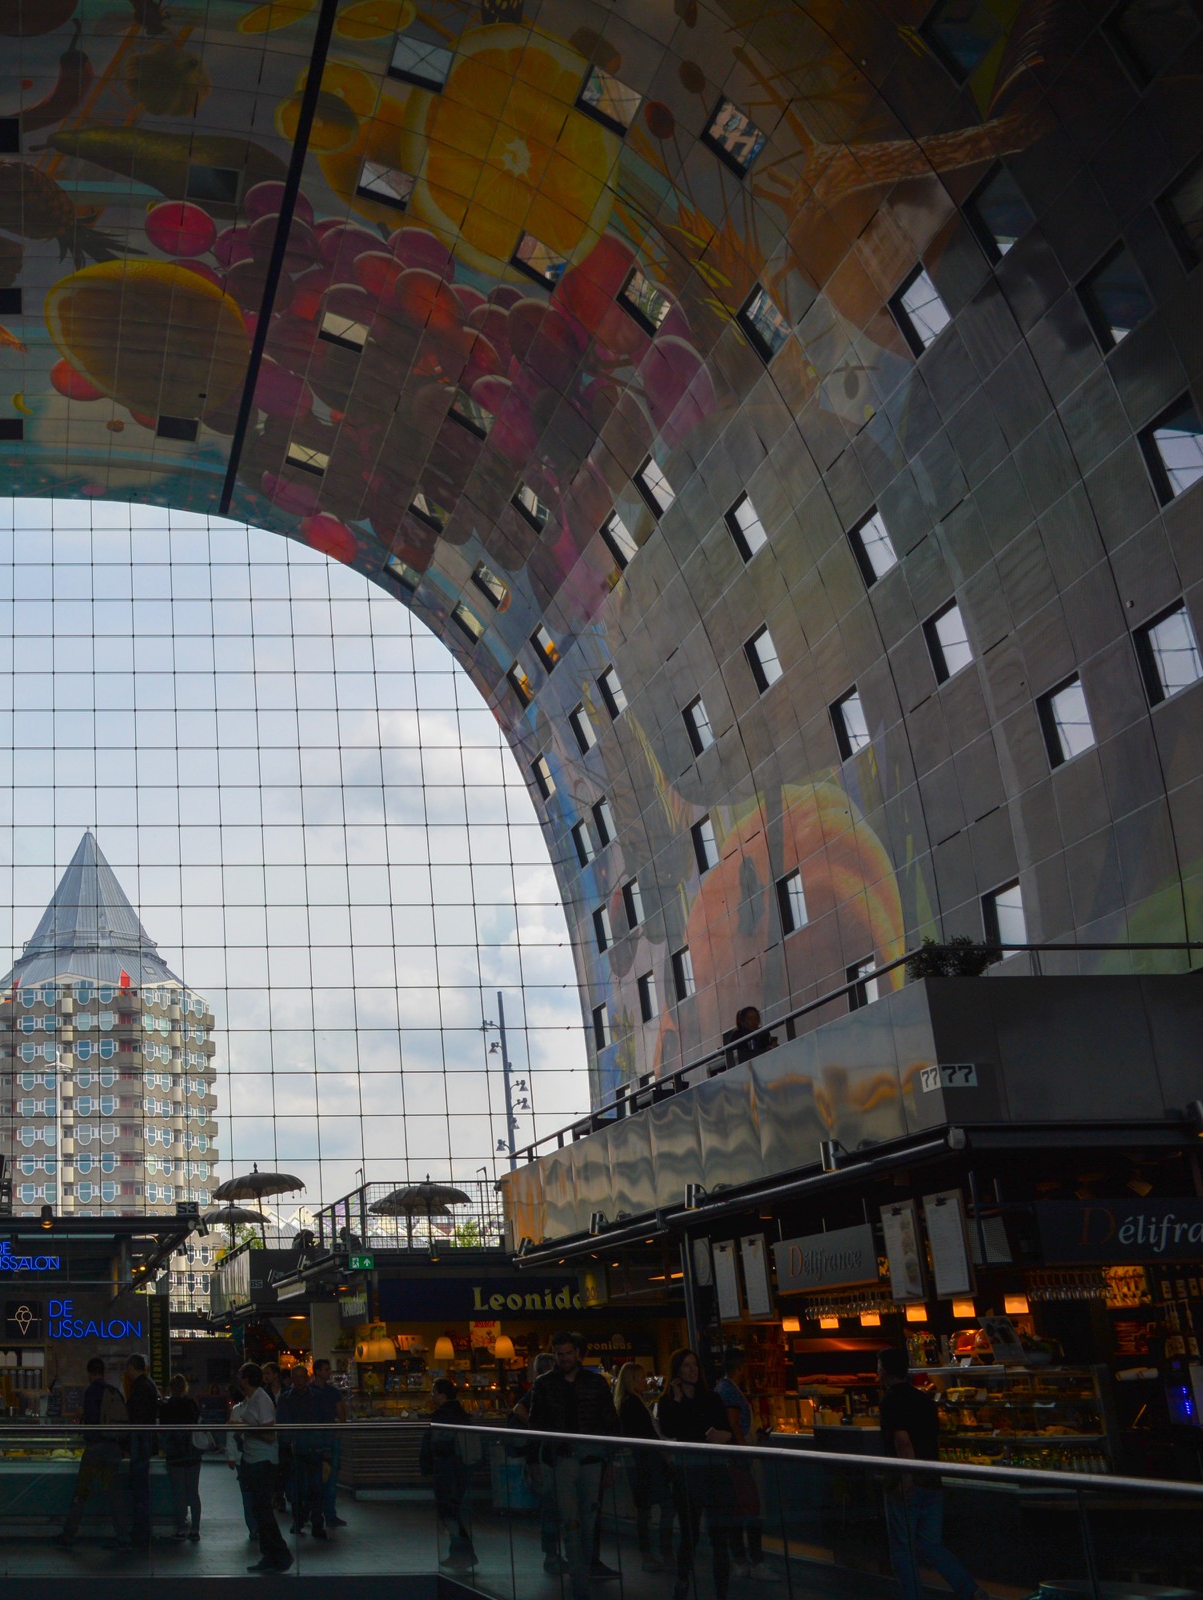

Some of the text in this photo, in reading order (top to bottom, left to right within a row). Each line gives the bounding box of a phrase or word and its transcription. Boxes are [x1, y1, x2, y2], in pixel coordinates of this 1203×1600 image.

[922, 1067, 937, 1088] 77
[941, 1066, 973, 1083] 77
[789, 1245, 862, 1281] Délifrance
[48, 1299, 74, 1318] DE
[48, 1319, 142, 1339] IJSSALON
[586, 1341, 633, 1350] eonidas
